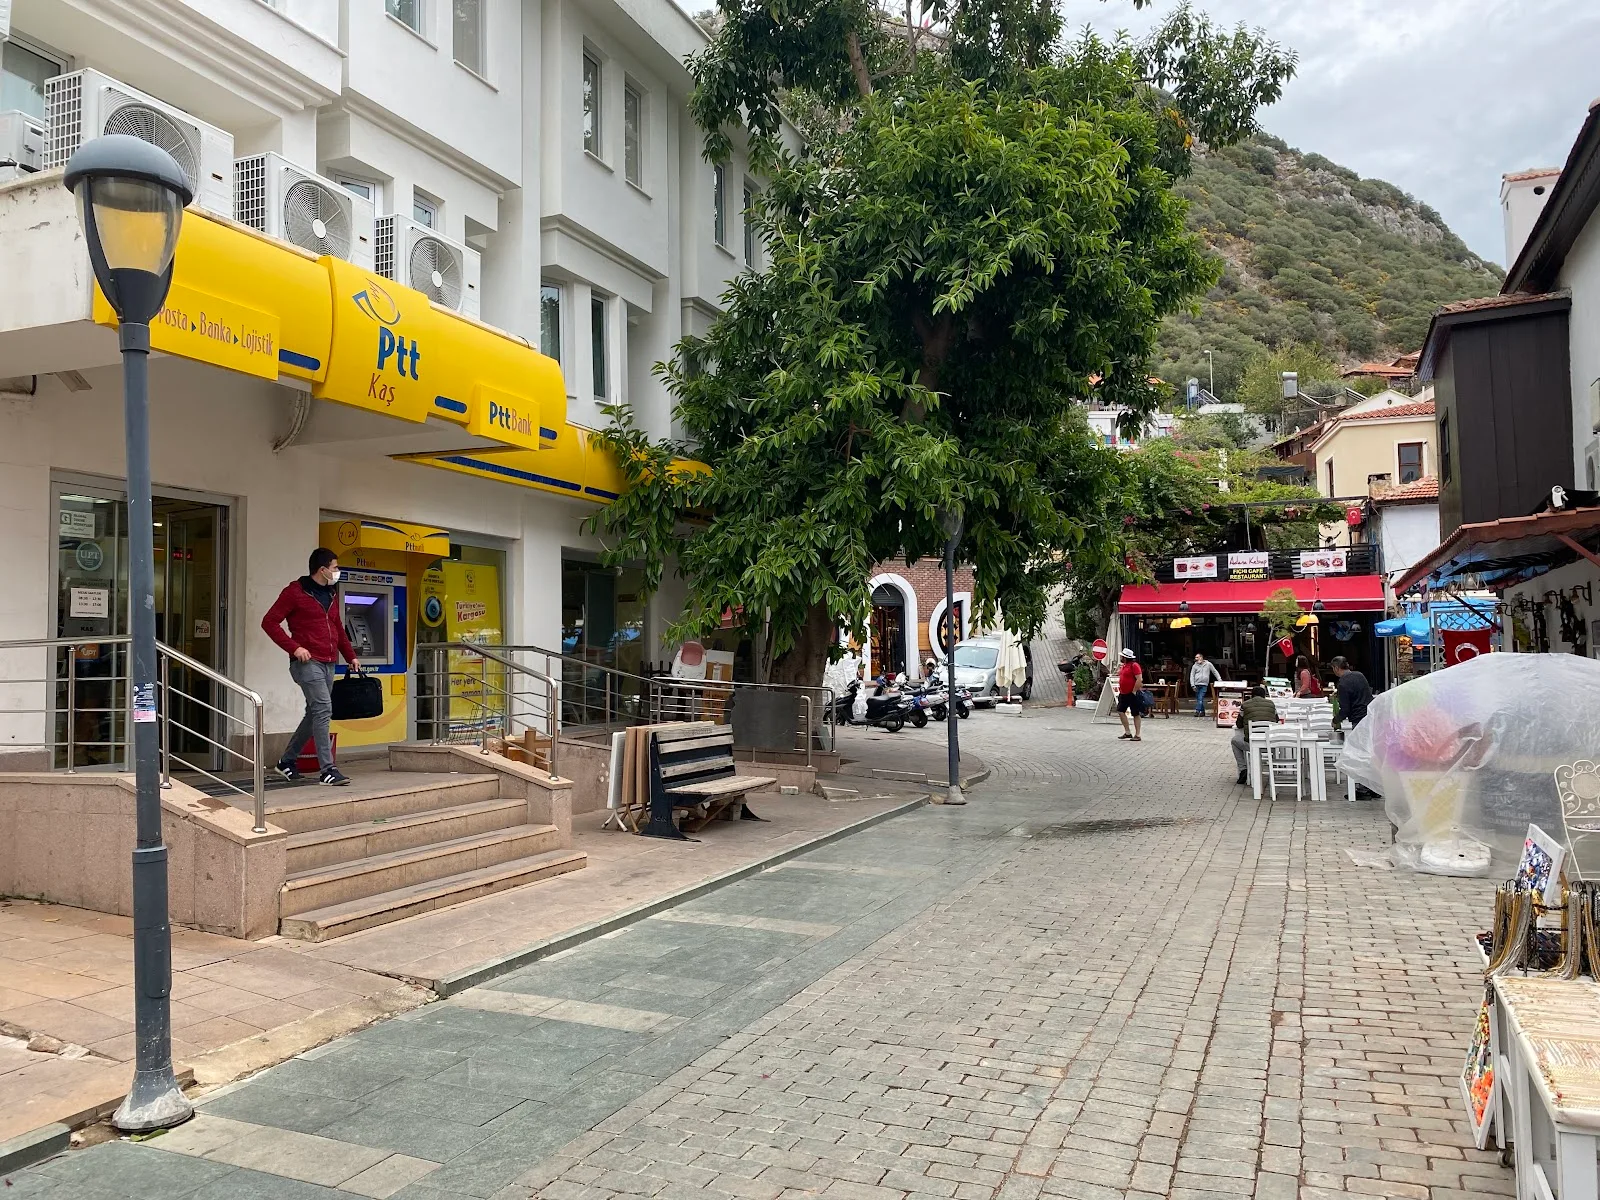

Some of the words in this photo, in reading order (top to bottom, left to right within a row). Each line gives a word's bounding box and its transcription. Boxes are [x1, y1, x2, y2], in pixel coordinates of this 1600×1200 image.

[159, 304, 188, 331] Posta
[200, 311, 231, 344] Banka
[241, 324, 274, 357] Lojistik
[377, 325, 421, 381] Ptt
[368, 372, 396, 407] Kaş
[489, 401, 532, 436] PttBank
[348, 530, 355, 538] 24
[80, 549, 100, 560] UPT
[457, 609, 486, 622] Kargosu
